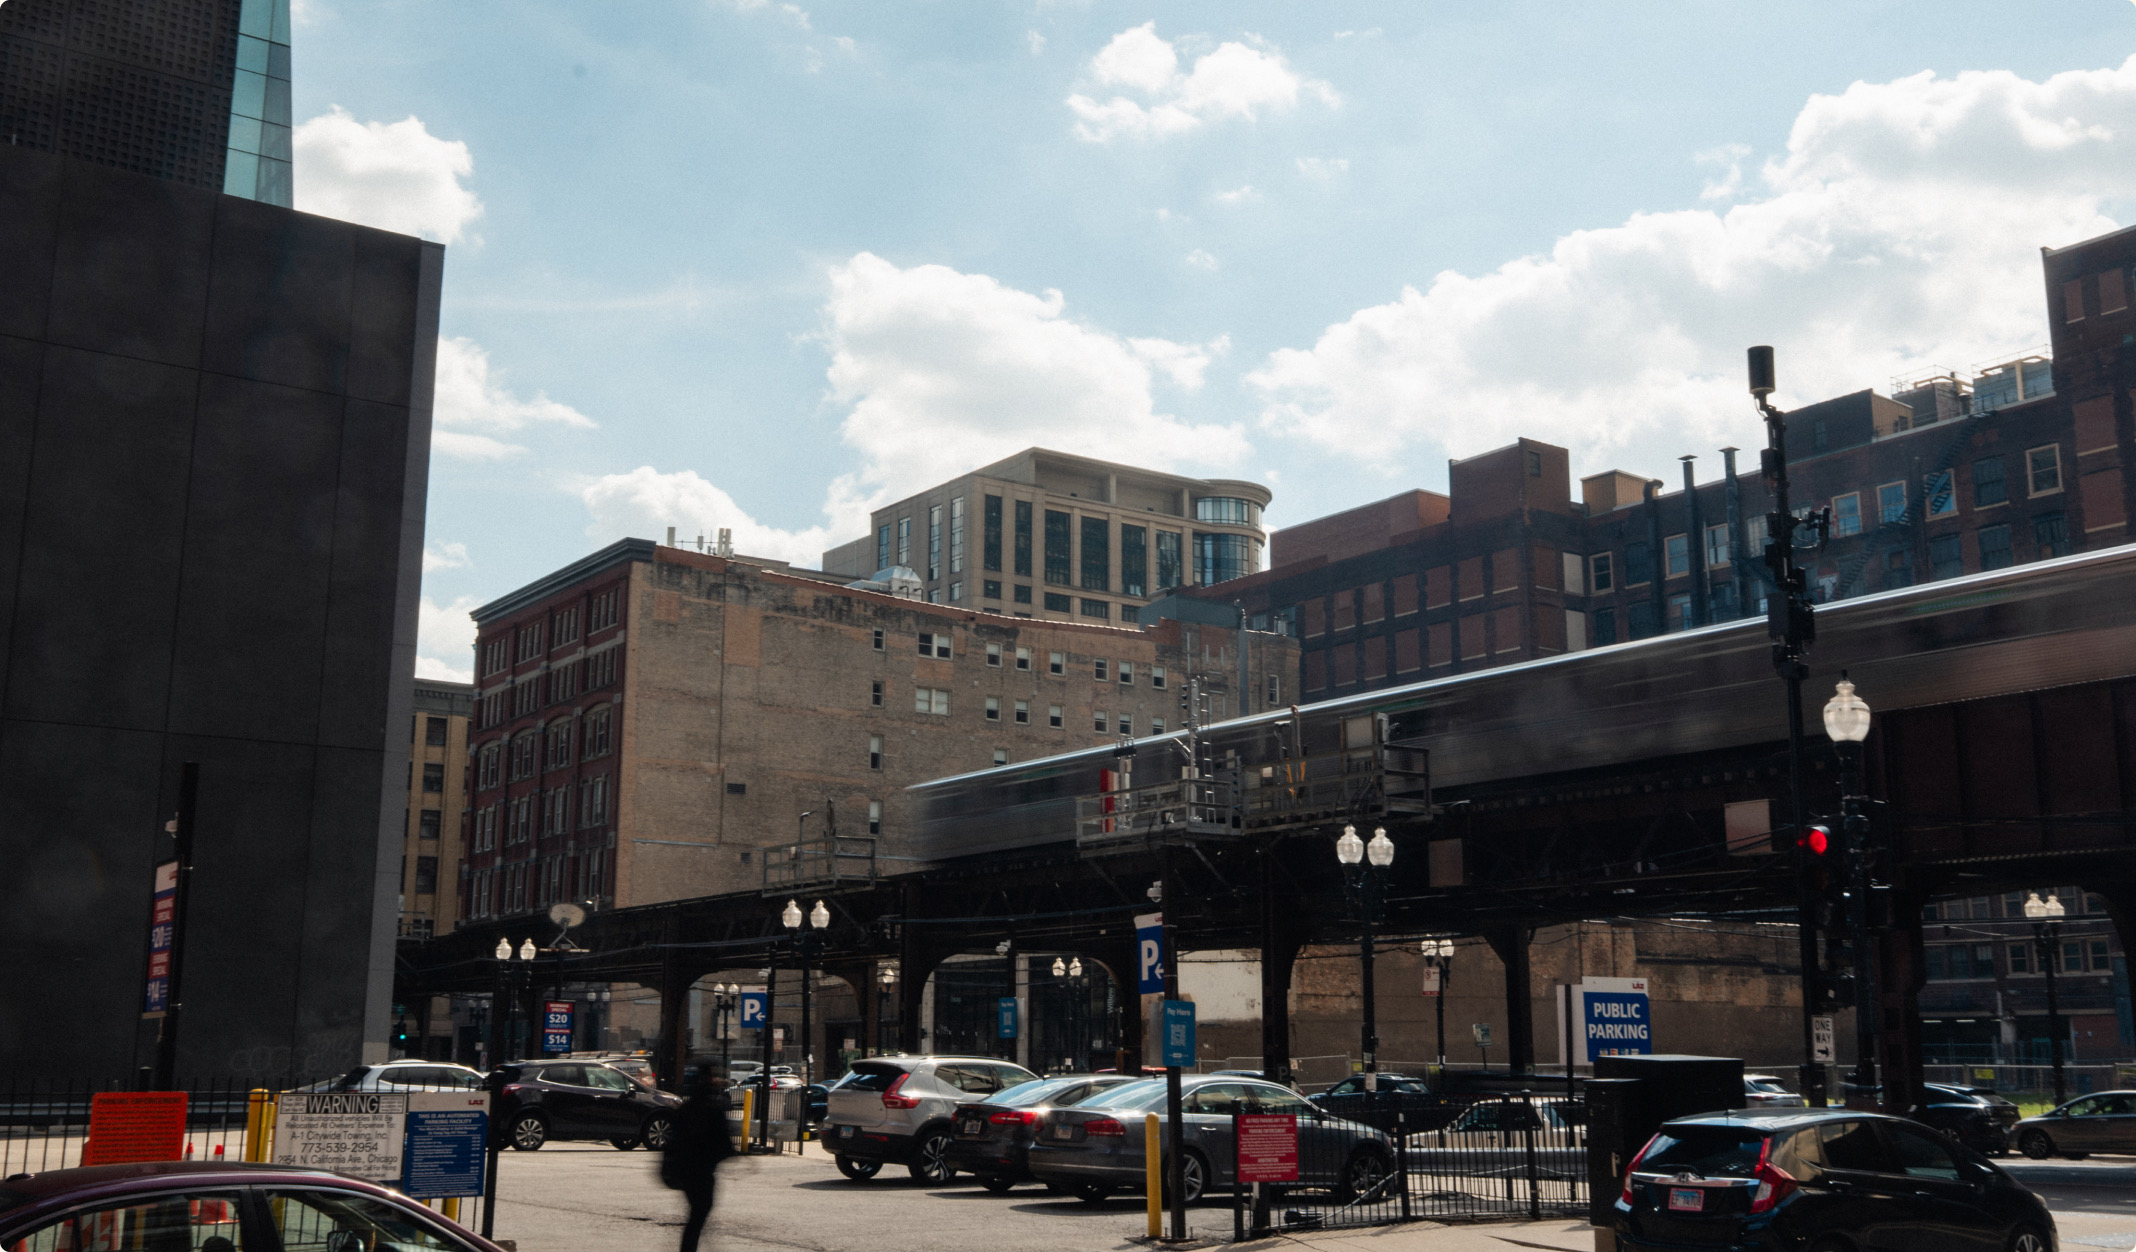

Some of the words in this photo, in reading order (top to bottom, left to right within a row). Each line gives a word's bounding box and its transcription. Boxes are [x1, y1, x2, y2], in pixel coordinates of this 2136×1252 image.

[1141, 939, 1159, 981] P
[744, 999, 761, 1021] P
[1166, 1007, 1175, 1017] Pay
[1176, 1008, 1191, 1016] Here
[1593, 1002, 1641, 1018] PUBLIC
[548, 1013, 568, 1023] $20
[1815, 1020, 1830, 1031] ONE
[1588, 1023, 1648, 1040] PARKING
[548, 1034, 567, 1044] $14
[1815, 1032, 1832, 1044] WAY
[308, 1095, 379, 1113] WARNING
[358, 1121, 385, 1130] Expense
[291, 1131, 303, 1140] A-1
[307, 1131, 341, 1142] Citywide
[343, 1131, 372, 1142] Towing,
[375, 1130, 389, 1140] Inc.
[301, 1142, 378, 1153] 773-539-2954
[278, 1155, 296, 1164] 2954
[310, 1154, 346, 1164] California
[367, 1154, 398, 1165] Chicago
